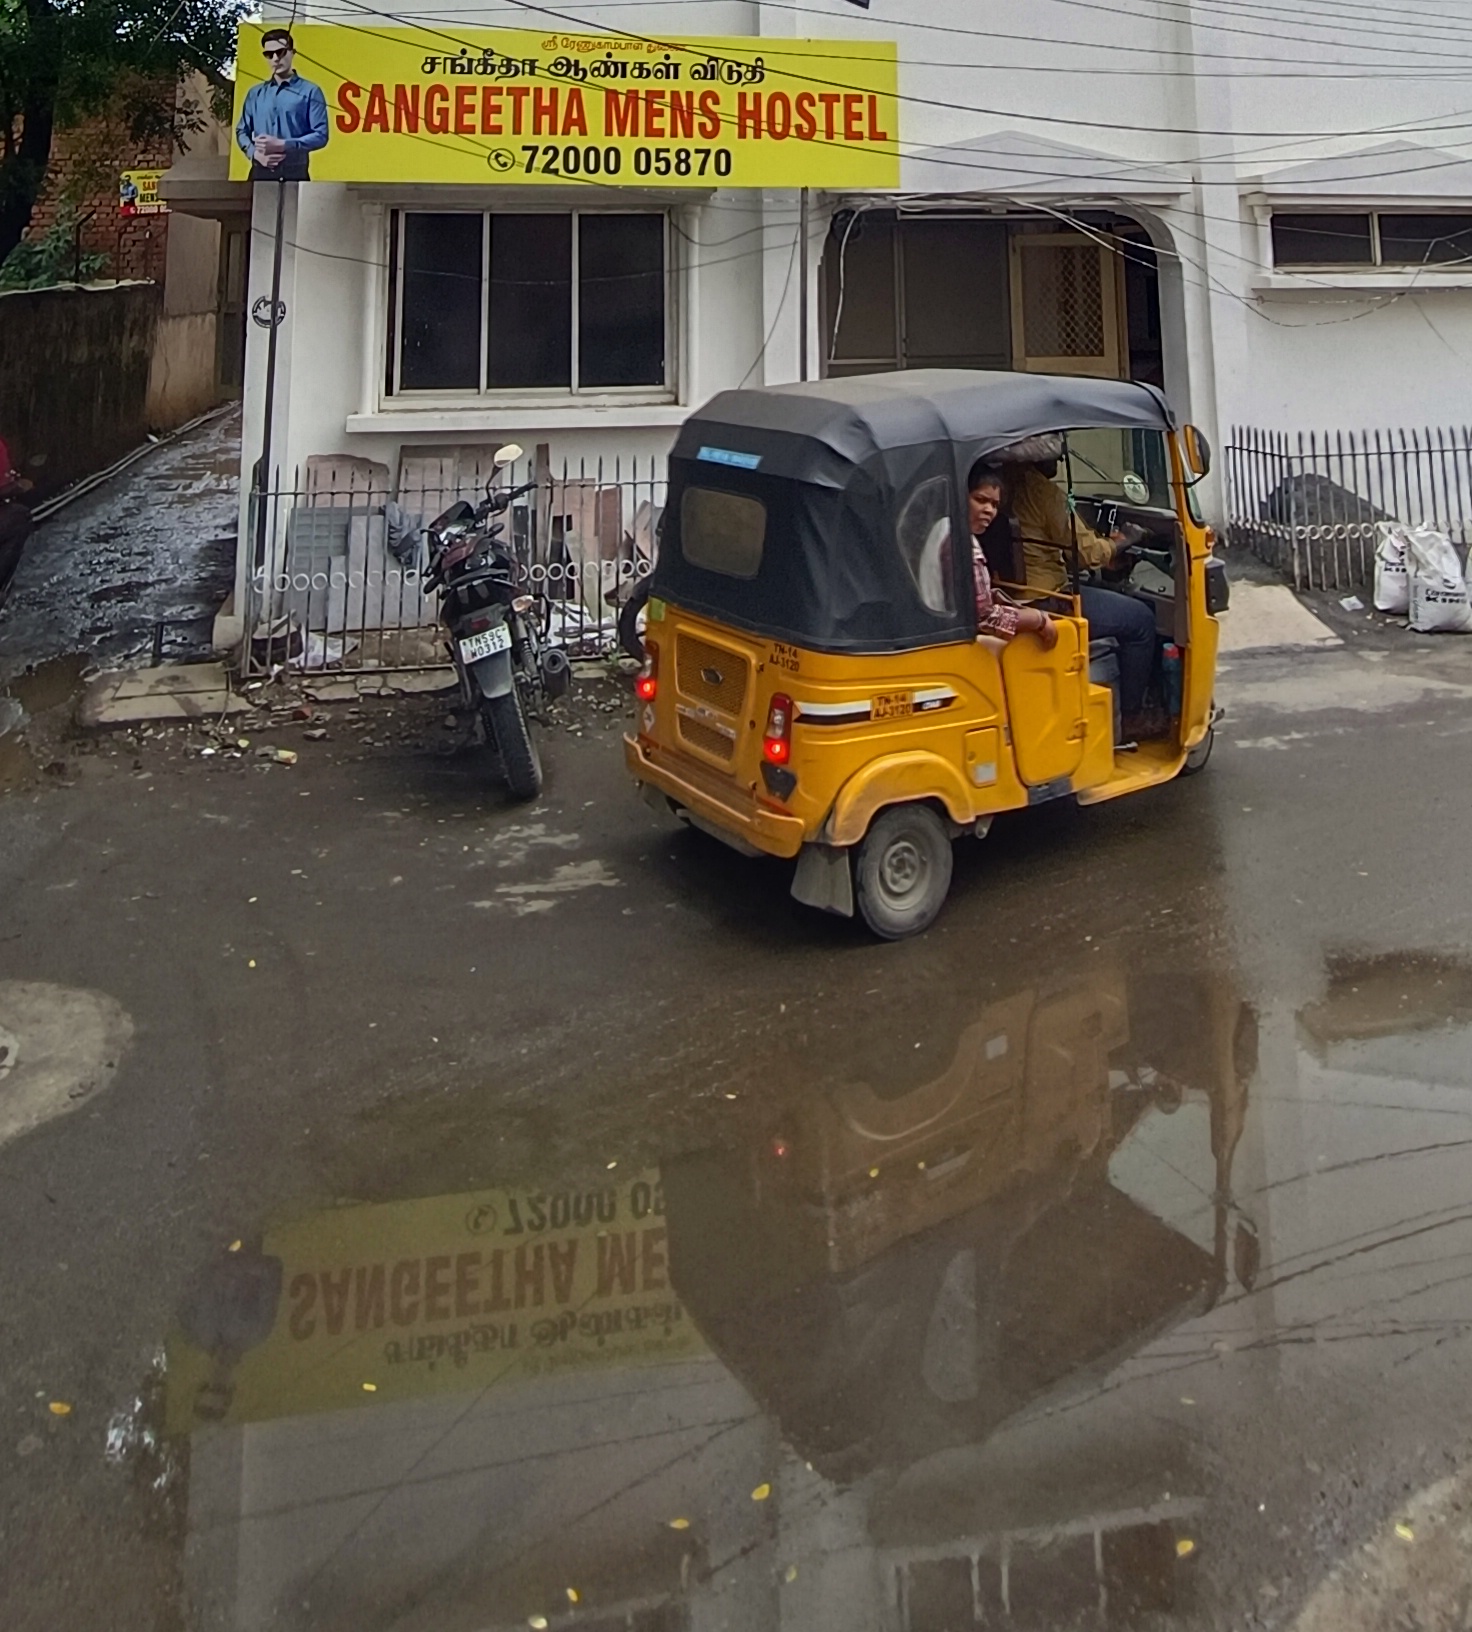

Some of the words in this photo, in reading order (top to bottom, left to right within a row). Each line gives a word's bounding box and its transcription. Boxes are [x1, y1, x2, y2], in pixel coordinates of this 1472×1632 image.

[421, 48, 539, 82] சங்கீதா
[547, 51, 682, 82] ஆண்கள்
[690, 56, 766, 87] விடுதி
[335, 80, 588, 137] SANGEETHA
[604, 88, 721, 140] MENS
[737, 91, 888, 142] HOSTEL
[521, 144, 621, 176] 72000
[633, 146, 732, 177] 05870
